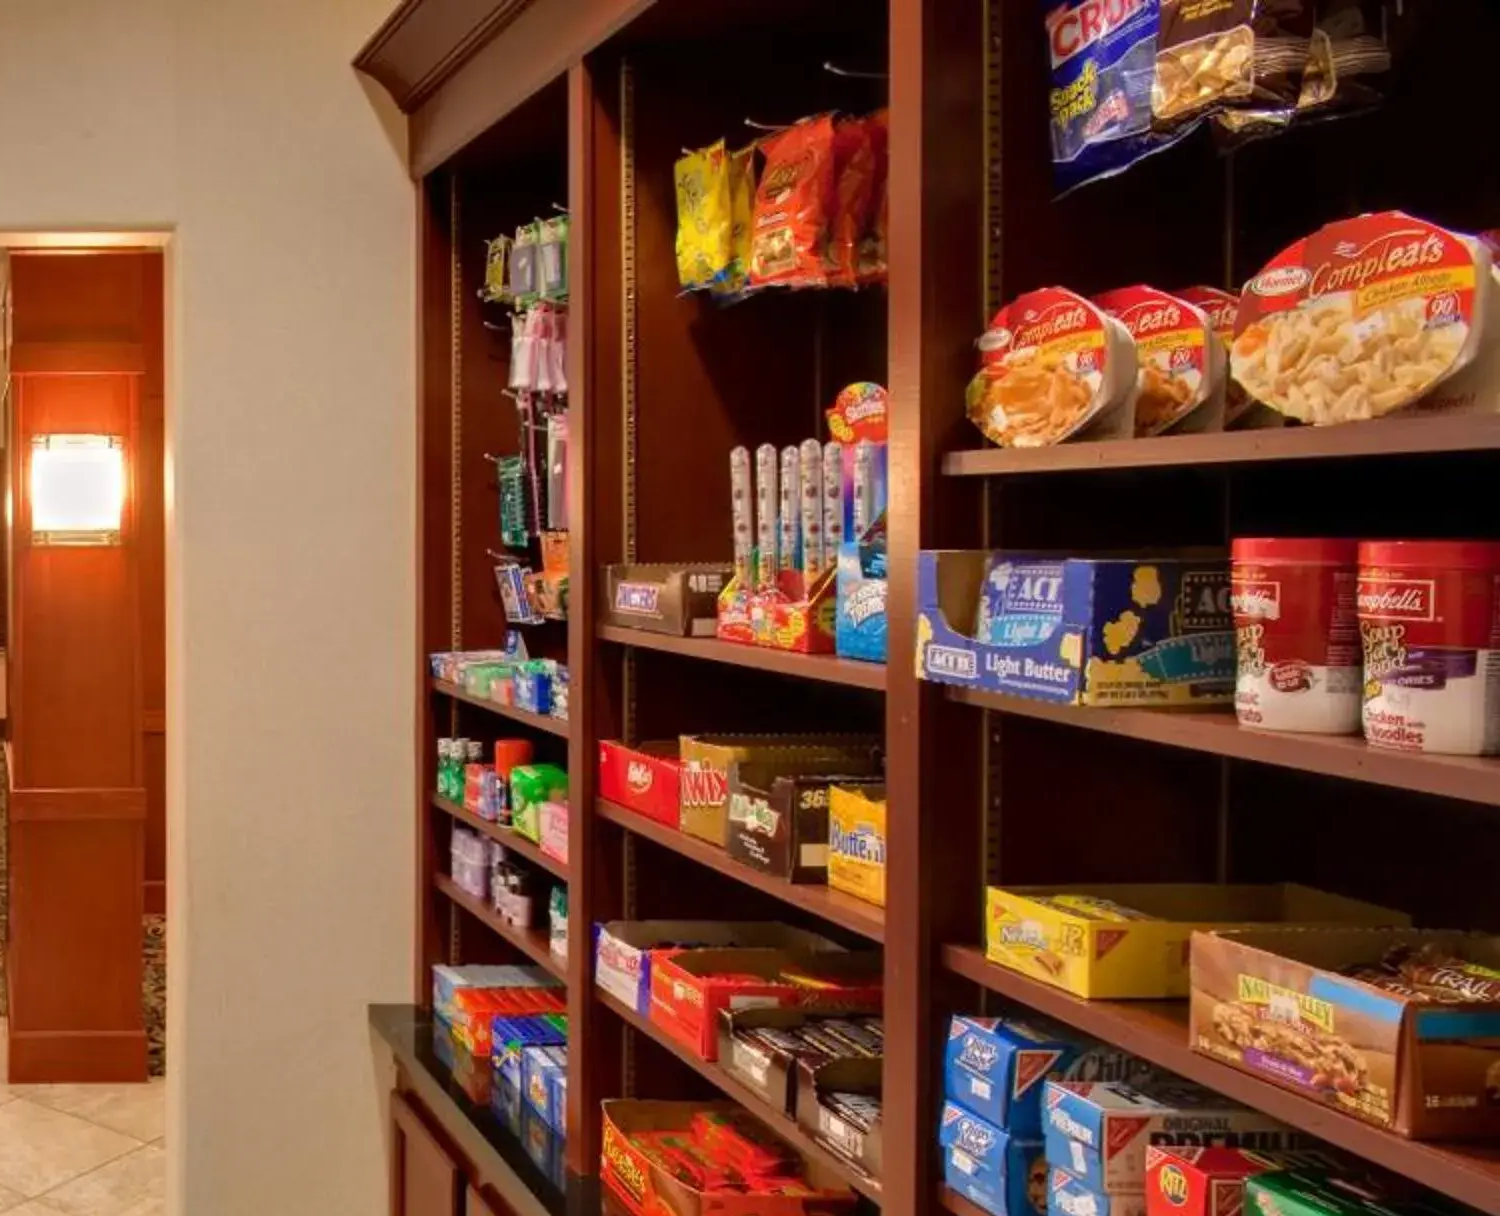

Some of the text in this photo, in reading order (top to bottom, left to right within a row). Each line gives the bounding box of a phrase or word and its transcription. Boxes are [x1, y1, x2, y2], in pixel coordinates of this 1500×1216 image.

[1309, 232, 1445, 299] Compleats
[1197, 586, 1232, 613] AC
[985, 652, 1071, 683] Light Butter
[1163, 1117, 1232, 1132] ORIGINAL
[1160, 1168, 1187, 1200] RITZ
